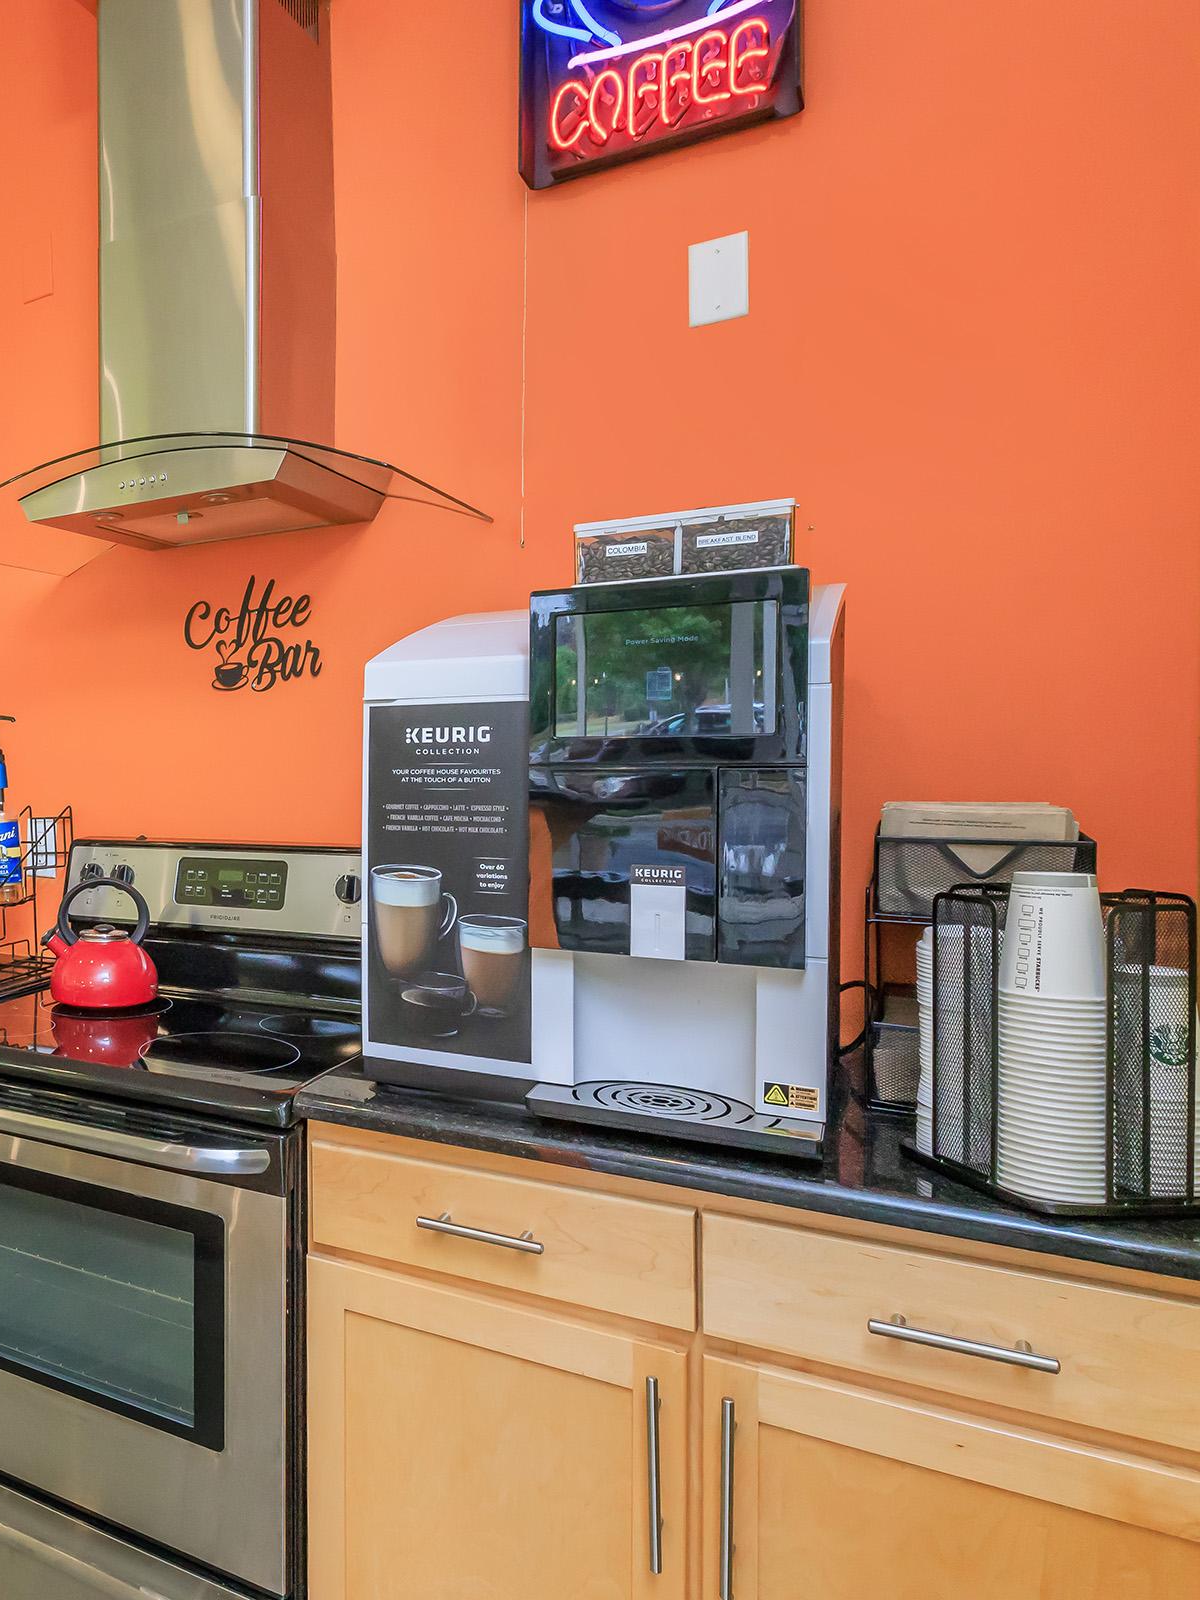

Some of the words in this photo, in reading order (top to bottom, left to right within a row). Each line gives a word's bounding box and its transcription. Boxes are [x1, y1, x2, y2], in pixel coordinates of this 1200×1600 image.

[551, 17, 769, 149] COFFEE
[608, 545, 646, 554] COLOMBIA
[184, 575, 312, 650] Coffee
[650, 636, 676, 644] Saving
[246, 637, 323, 692] Bar
[405, 726, 492, 744] KEURIG
[635, 868, 682, 878] KEURIG
[487, 882, 505, 890] enjoy
